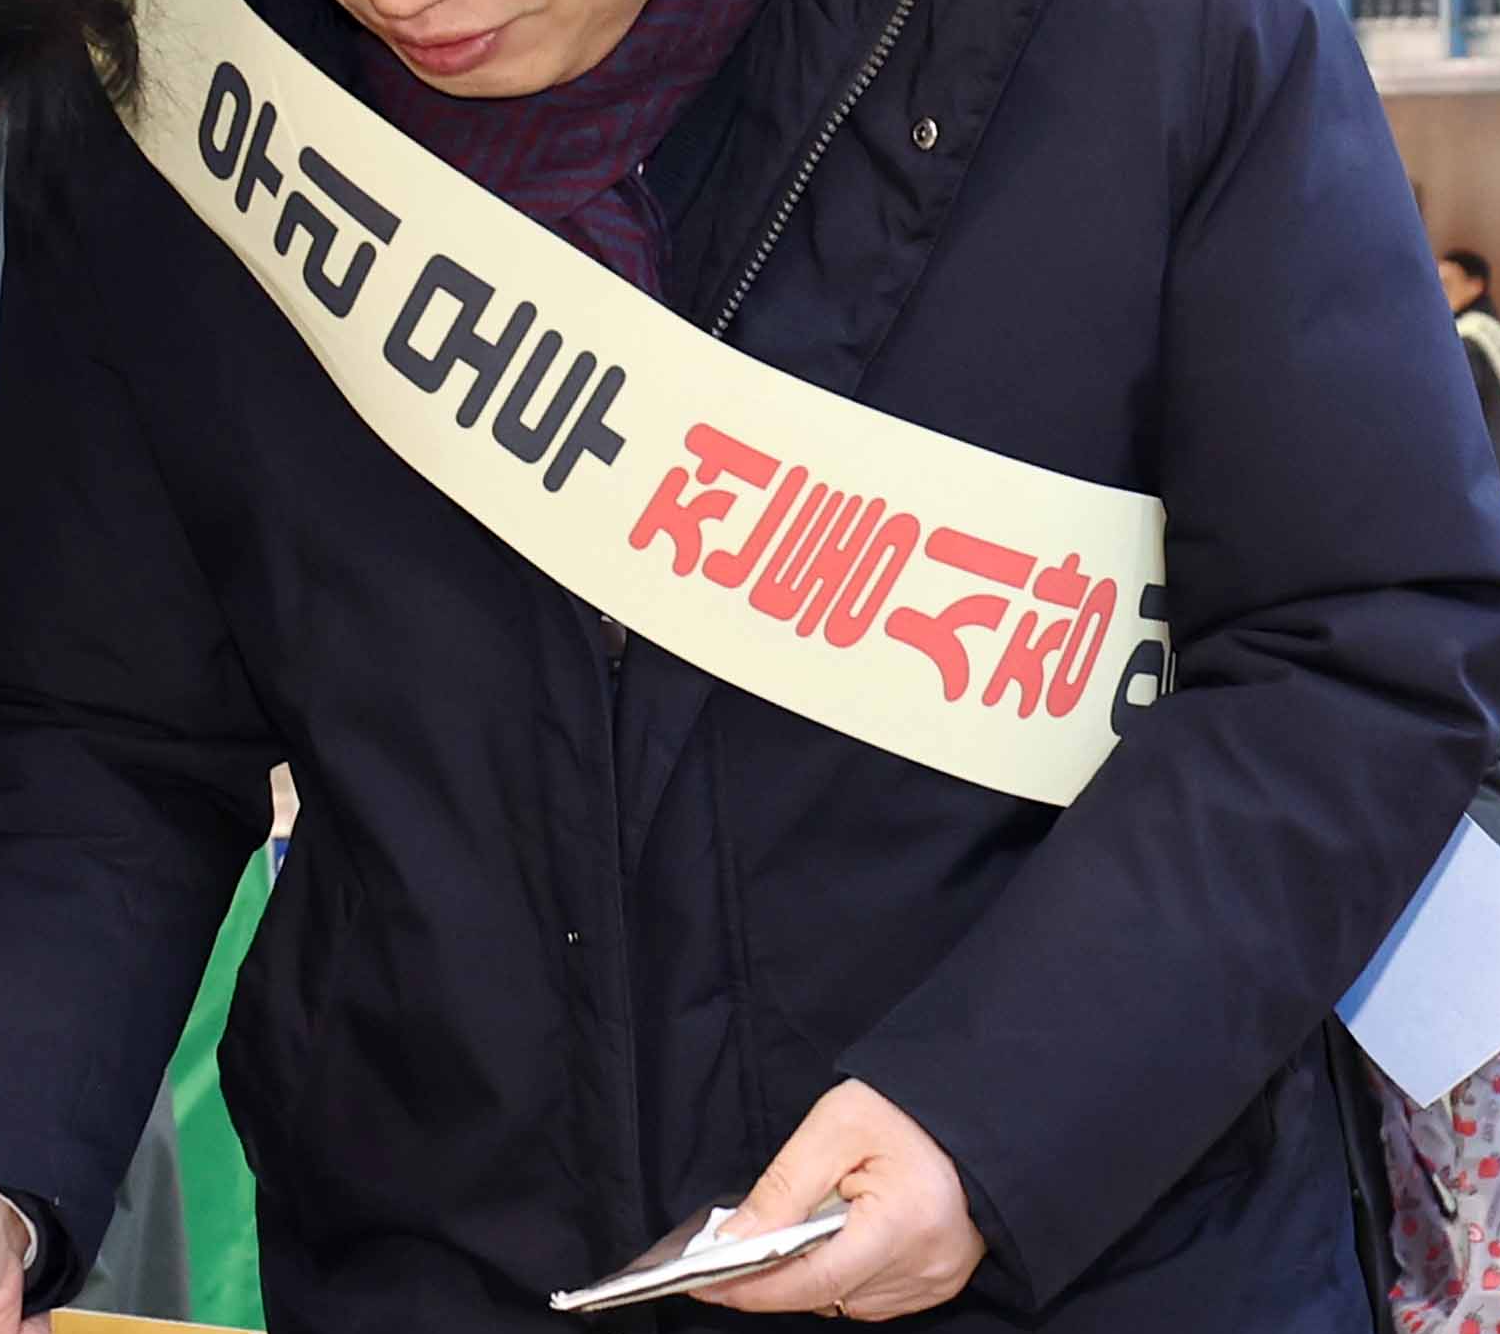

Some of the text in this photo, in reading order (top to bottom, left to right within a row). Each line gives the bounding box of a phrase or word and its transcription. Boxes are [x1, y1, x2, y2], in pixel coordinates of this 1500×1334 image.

[198, 60, 402, 318] 우리
[383, 252, 625, 493] 모두
[628, 421, 1118, 720] 전통시장
